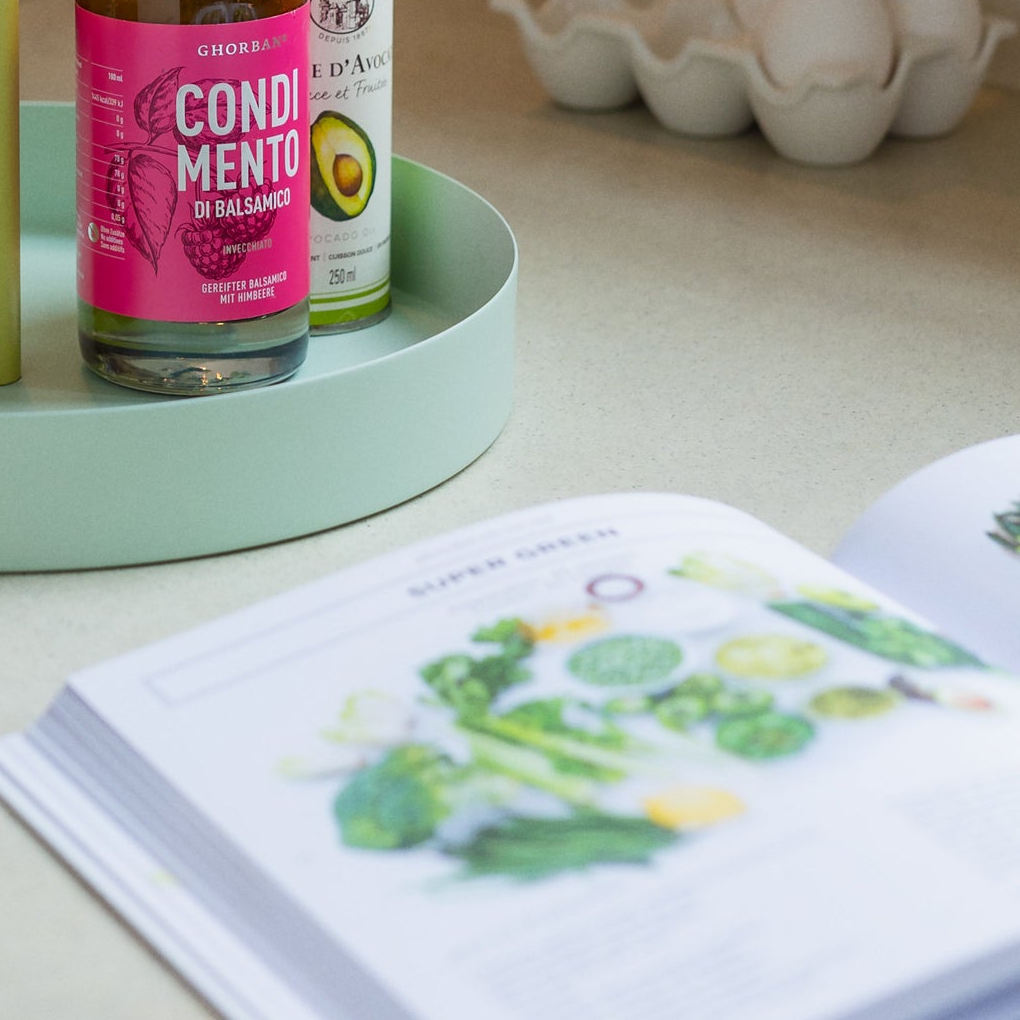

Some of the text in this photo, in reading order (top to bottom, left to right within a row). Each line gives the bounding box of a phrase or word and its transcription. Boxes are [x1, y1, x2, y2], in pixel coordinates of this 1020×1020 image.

[318, 32, 350, 44] DEPUIS
[335, 86, 350, 99] et
[175, 68, 298, 136] CONDI
[177, 129, 299, 191] MENTO
[194, 187, 291, 219] DI BALSAMICO
[223, 238, 272, 255] INVECCHIATO
[311, 231, 358, 244] OCADO
[202, 271, 287, 293] GEREIFTER BALSAMICO
[329, 266, 356, 285] 250 ml
[220, 286, 275, 304] MIT HIMBEERE
